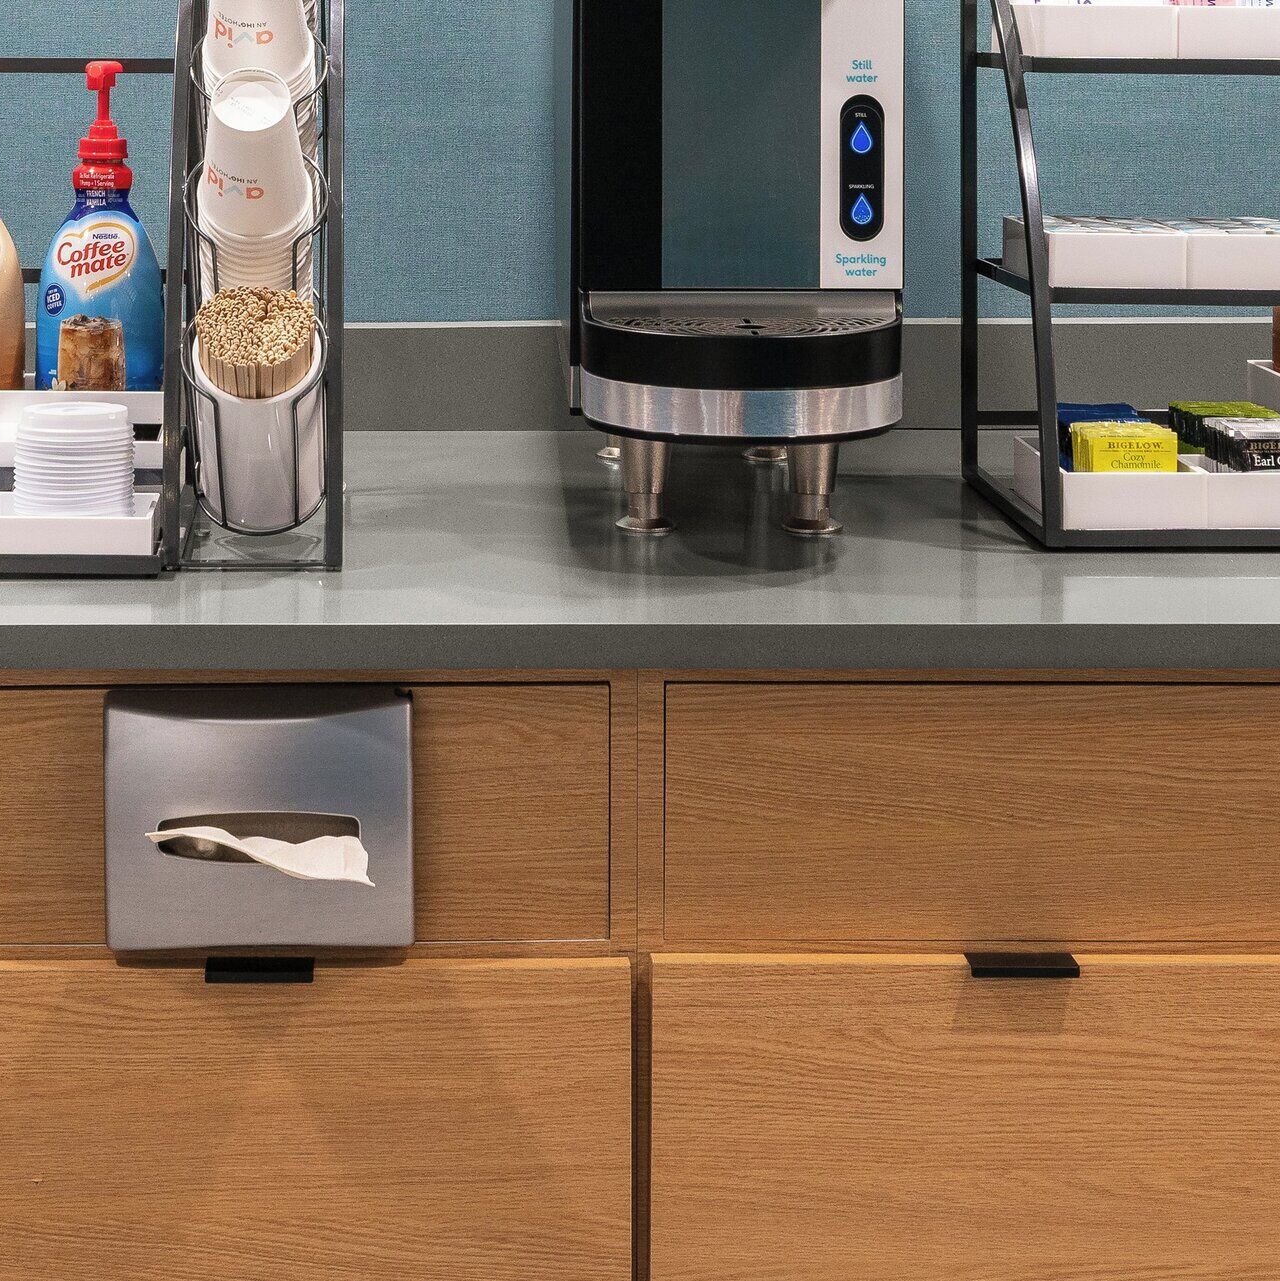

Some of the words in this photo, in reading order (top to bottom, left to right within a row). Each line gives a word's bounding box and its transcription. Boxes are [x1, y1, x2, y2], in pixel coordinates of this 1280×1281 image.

[852, 60, 872, 70] Still
[846, 74, 878, 83] water
[57, 241, 125, 265] Coffee
[835, 253, 886, 267] Sparkling
[71, 253, 126, 278] mate
[845, 267, 877, 277] water
[47, 293, 60, 303] ICED
[1124, 453, 1145, 461] Cozy
[1253, 455, 1275, 466] Earl
[1111, 460, 1161, 468] Chamomile
